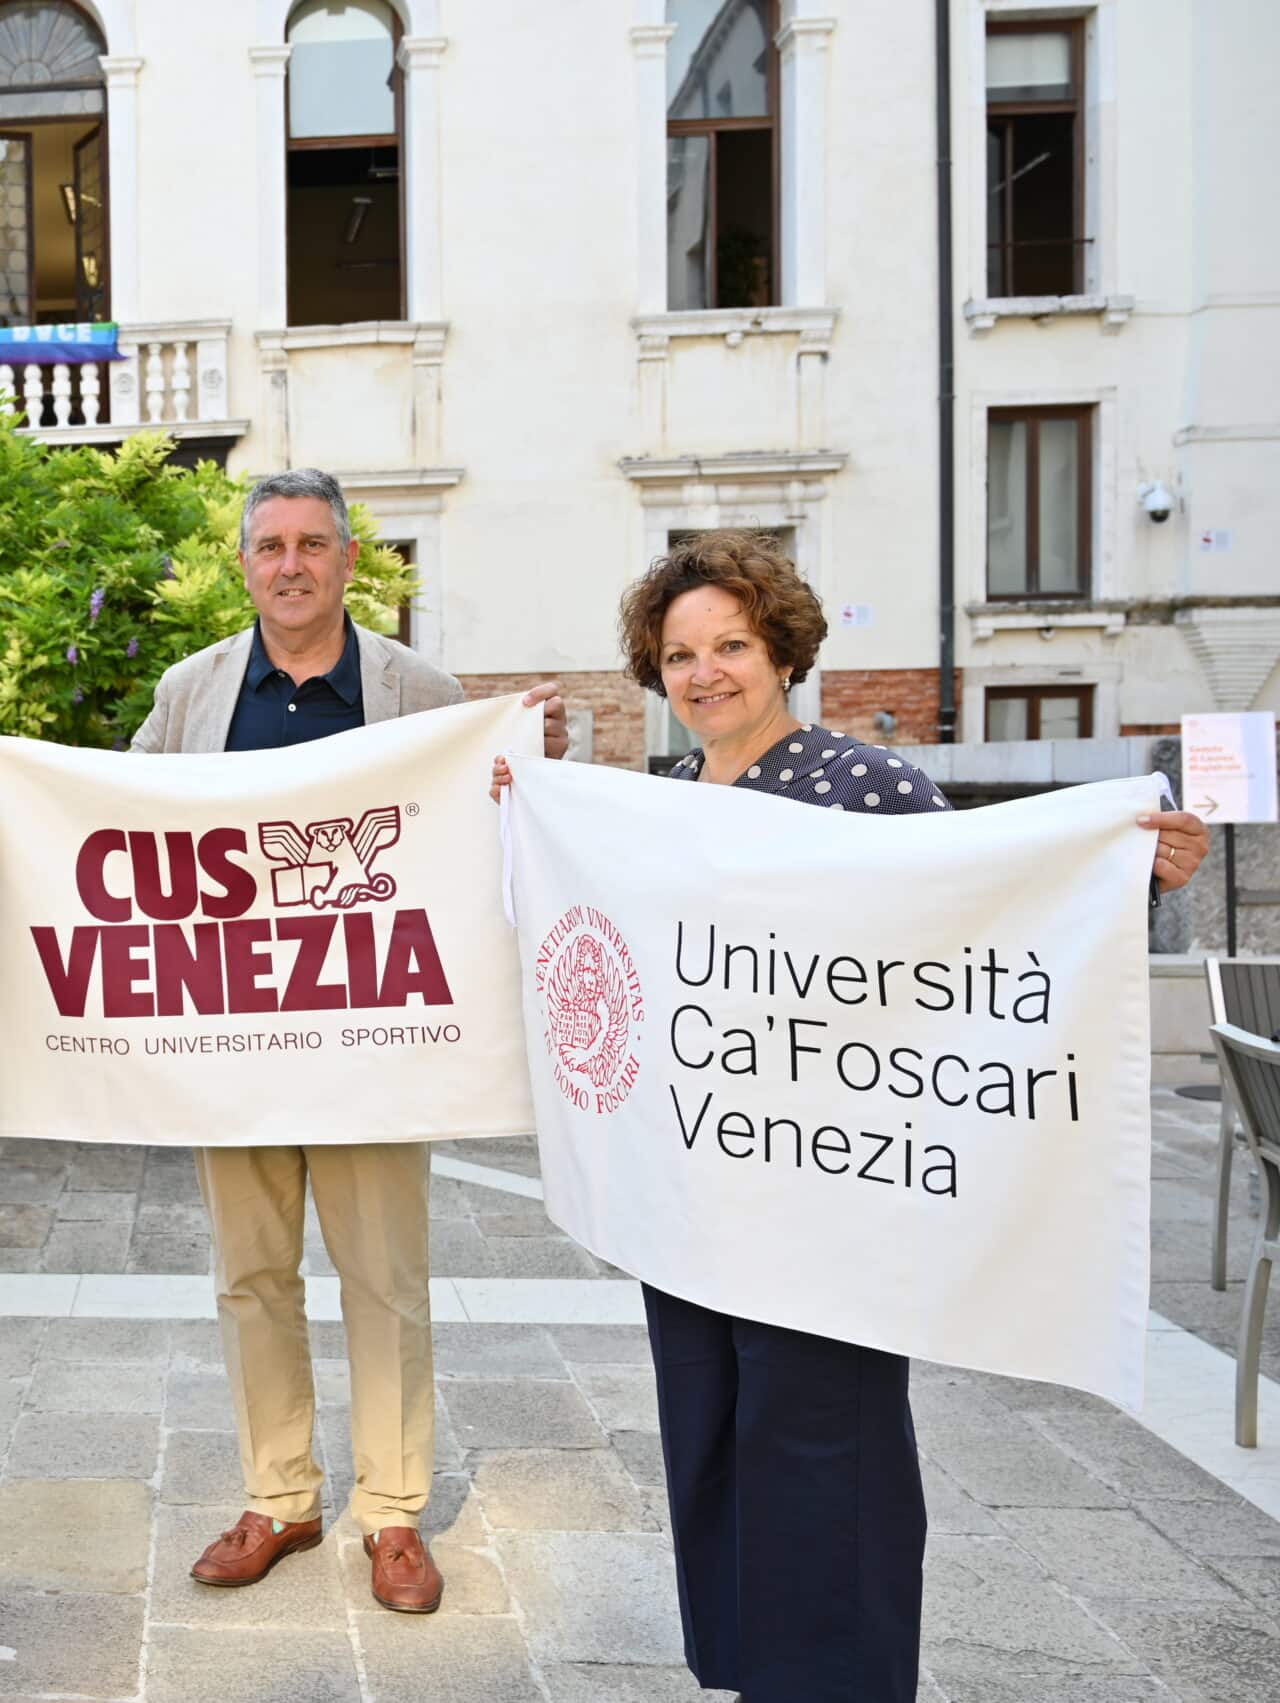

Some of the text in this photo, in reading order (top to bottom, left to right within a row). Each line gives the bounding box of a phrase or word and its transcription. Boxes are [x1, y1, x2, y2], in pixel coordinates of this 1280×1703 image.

[76, 827, 258, 923] CUS
[30, 908, 454, 1018] VENEZIA
[676, 921, 1051, 1025] Università
[45, 1024, 462, 1056] CENTRO UNIVERSITARIO SPORTIVO
[554, 1053, 640, 1114] DOMO FOSCARI
[669, 1084, 958, 1198] Venezia
